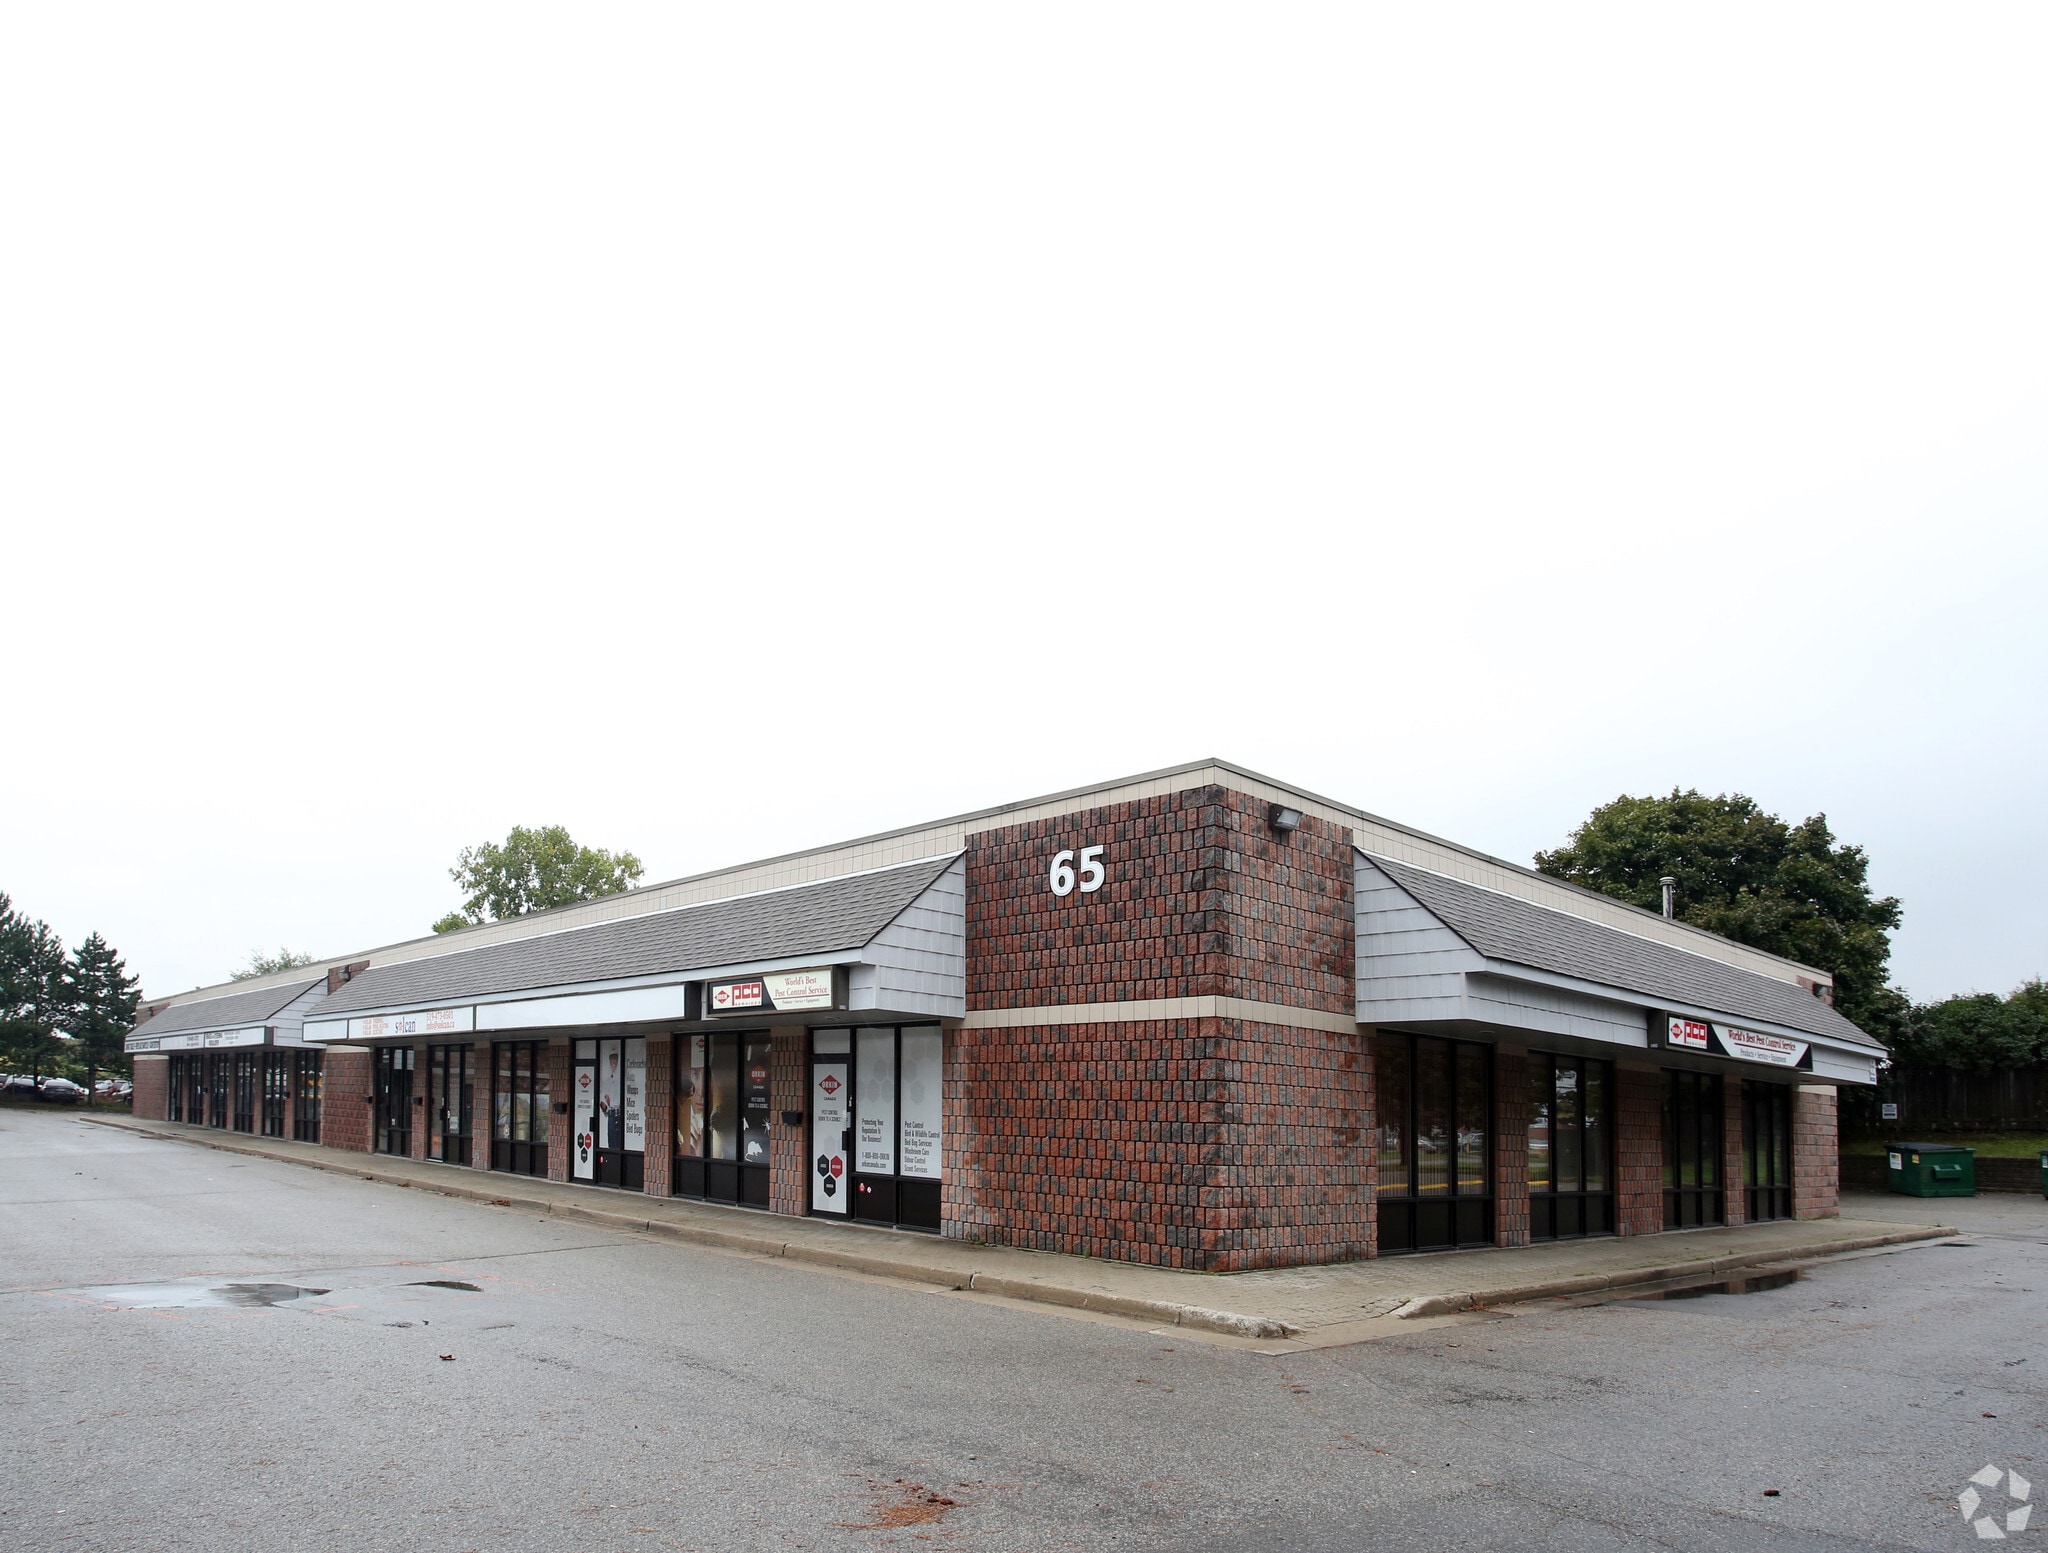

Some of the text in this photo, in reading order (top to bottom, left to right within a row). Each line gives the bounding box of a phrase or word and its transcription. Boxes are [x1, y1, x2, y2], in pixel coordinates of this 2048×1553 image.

[1050, 845, 1104, 896] 65
[784, 976, 817, 986] World's Best
[775, 985, 828, 998] Pest Control Service
[395, 1016, 416, 1033] solcan
[1728, 1028, 1796, 1051] World's Best Pest Control Service
[821, 1081, 838, 1089] ORKIN
[627, 1097, 636, 1108] Mice
[634, 1123, 643, 1136] Bugs
[915, 1130, 927, 1138] Wildlife
[928, 1131, 940, 1139] Control
[918, 1139, 932, 1147] Services
[914, 1156, 926, 1164] Control
[914, 1165, 928, 1173] Services
